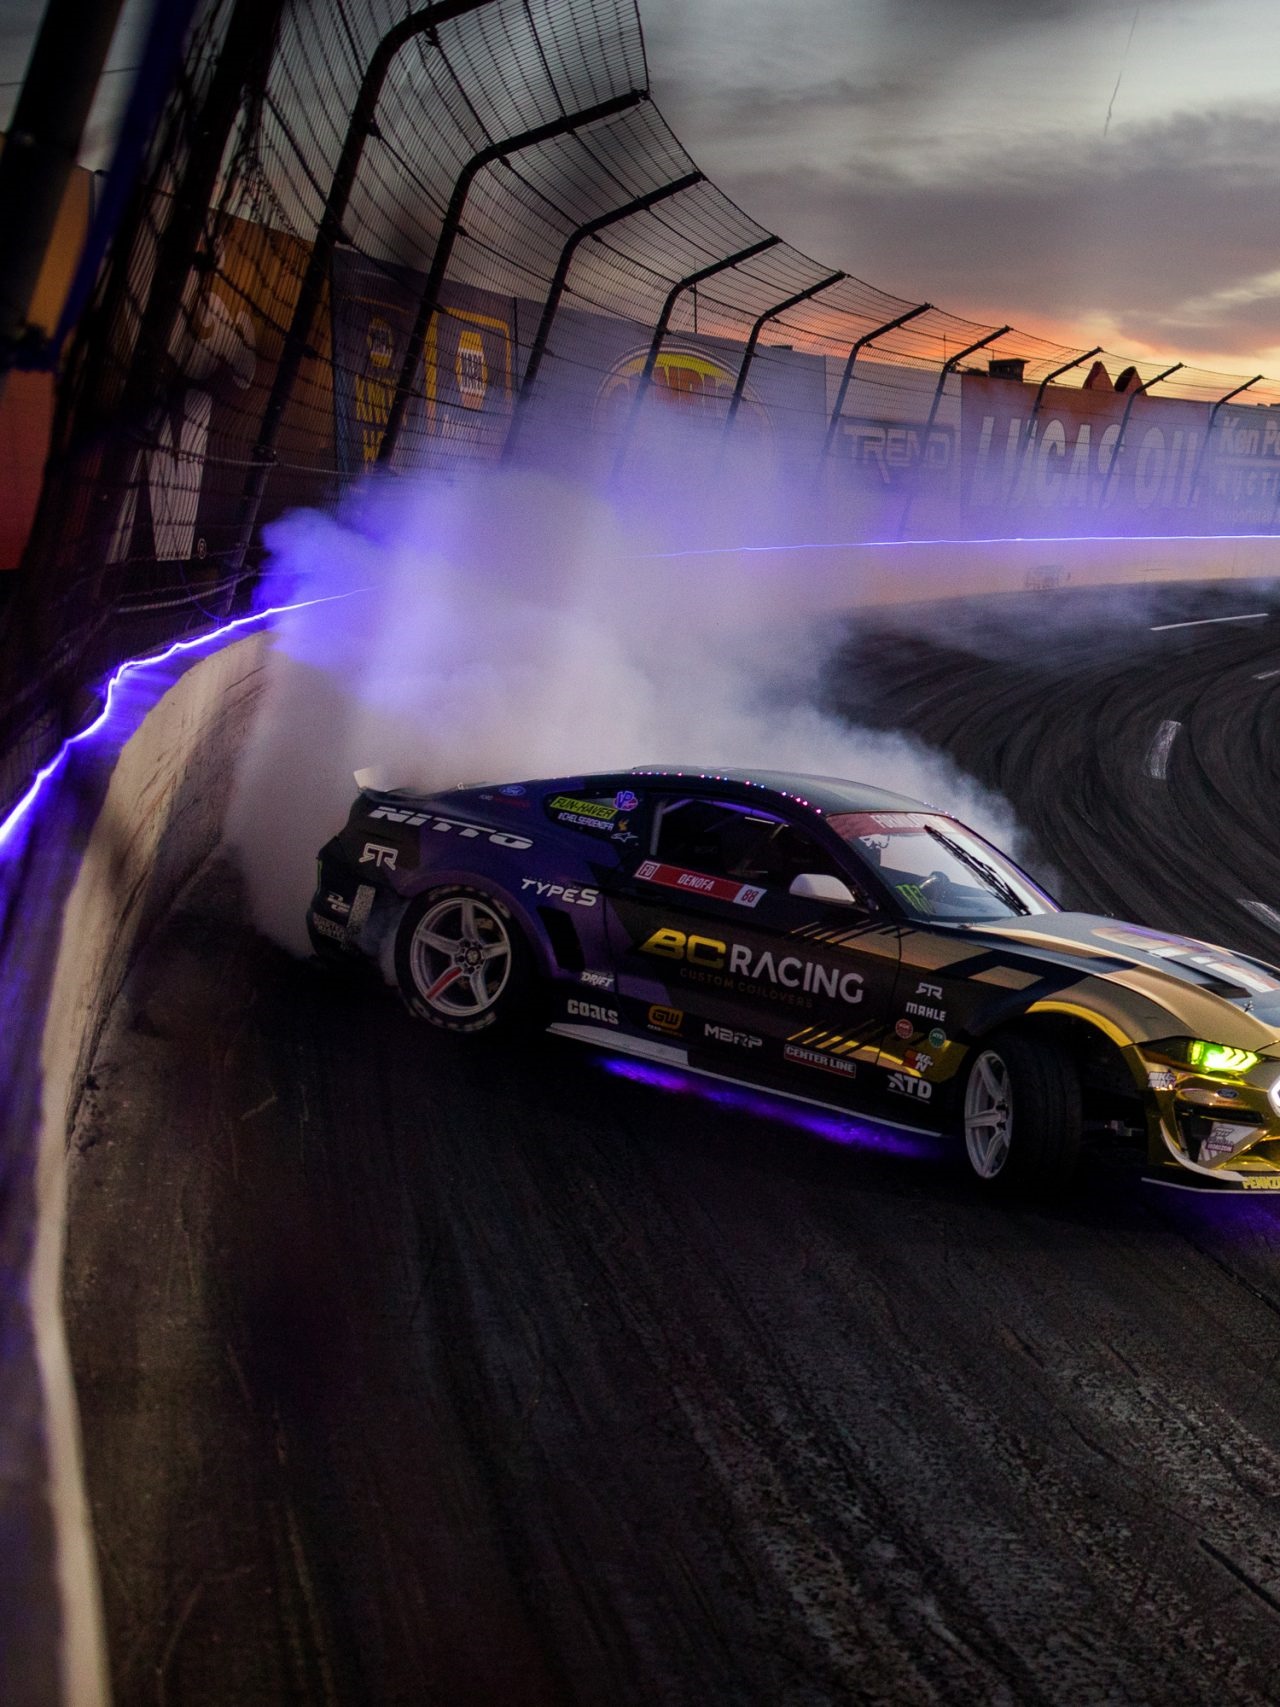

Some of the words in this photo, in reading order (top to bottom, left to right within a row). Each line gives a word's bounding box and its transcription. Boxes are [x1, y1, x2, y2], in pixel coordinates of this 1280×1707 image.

[1134, 426, 1203, 509] OIL
[553, 797, 615, 819] FUN-HAVER
[367, 805, 534, 850] NITTO
[639, 927, 728, 971] BC
[729, 943, 865, 1005] RACING
[680, 967, 735, 990] CUSTOM
[905, 1002, 947, 1022] MAHLE
[785, 1045, 829, 1067] CENTER
[829, 1055, 855, 1073] LINE
